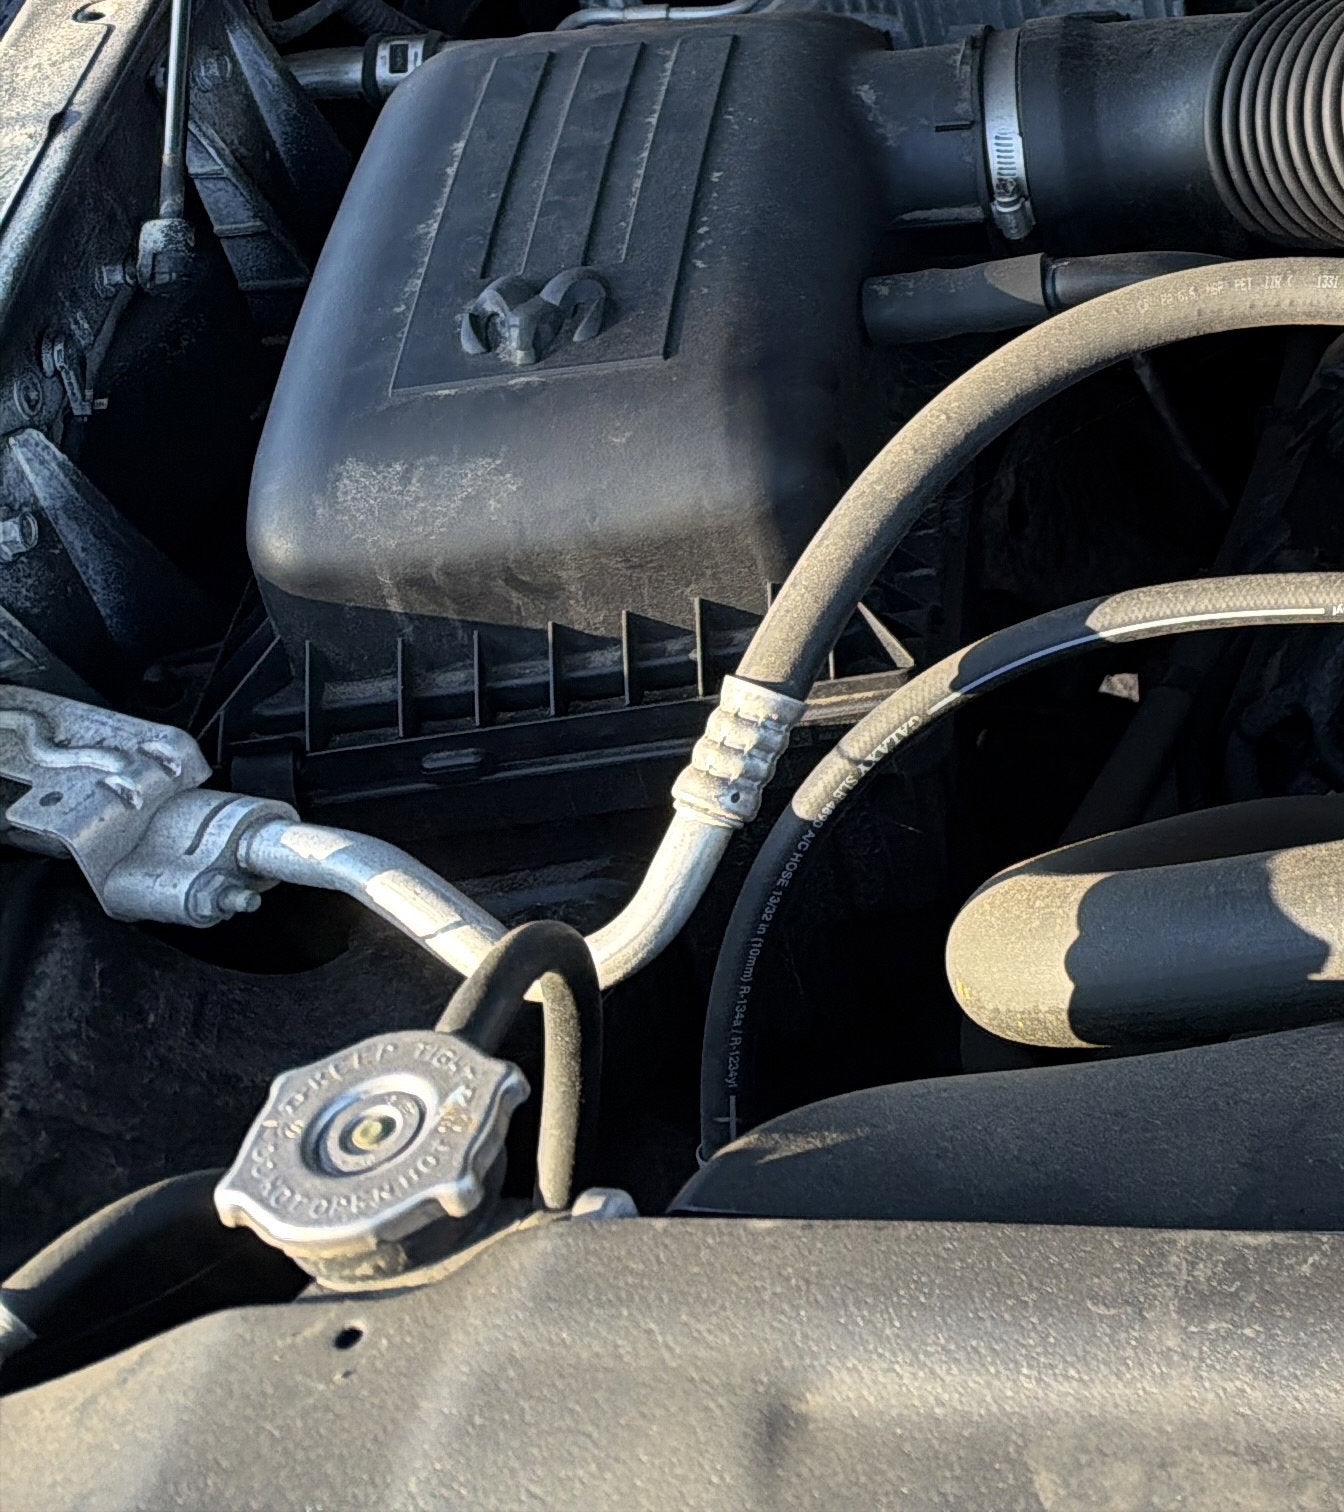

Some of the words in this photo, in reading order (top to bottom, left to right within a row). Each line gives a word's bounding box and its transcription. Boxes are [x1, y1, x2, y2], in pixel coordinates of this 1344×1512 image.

[857, 715, 922, 777] GALAXY
[798, 829, 816, 851] A/C
[776, 851, 803, 888] HOSE
[761, 890, 783, 921] 13/32
[740, 937, 765, 983] (10mm)
[733, 985, 751, 1027] R-134a
